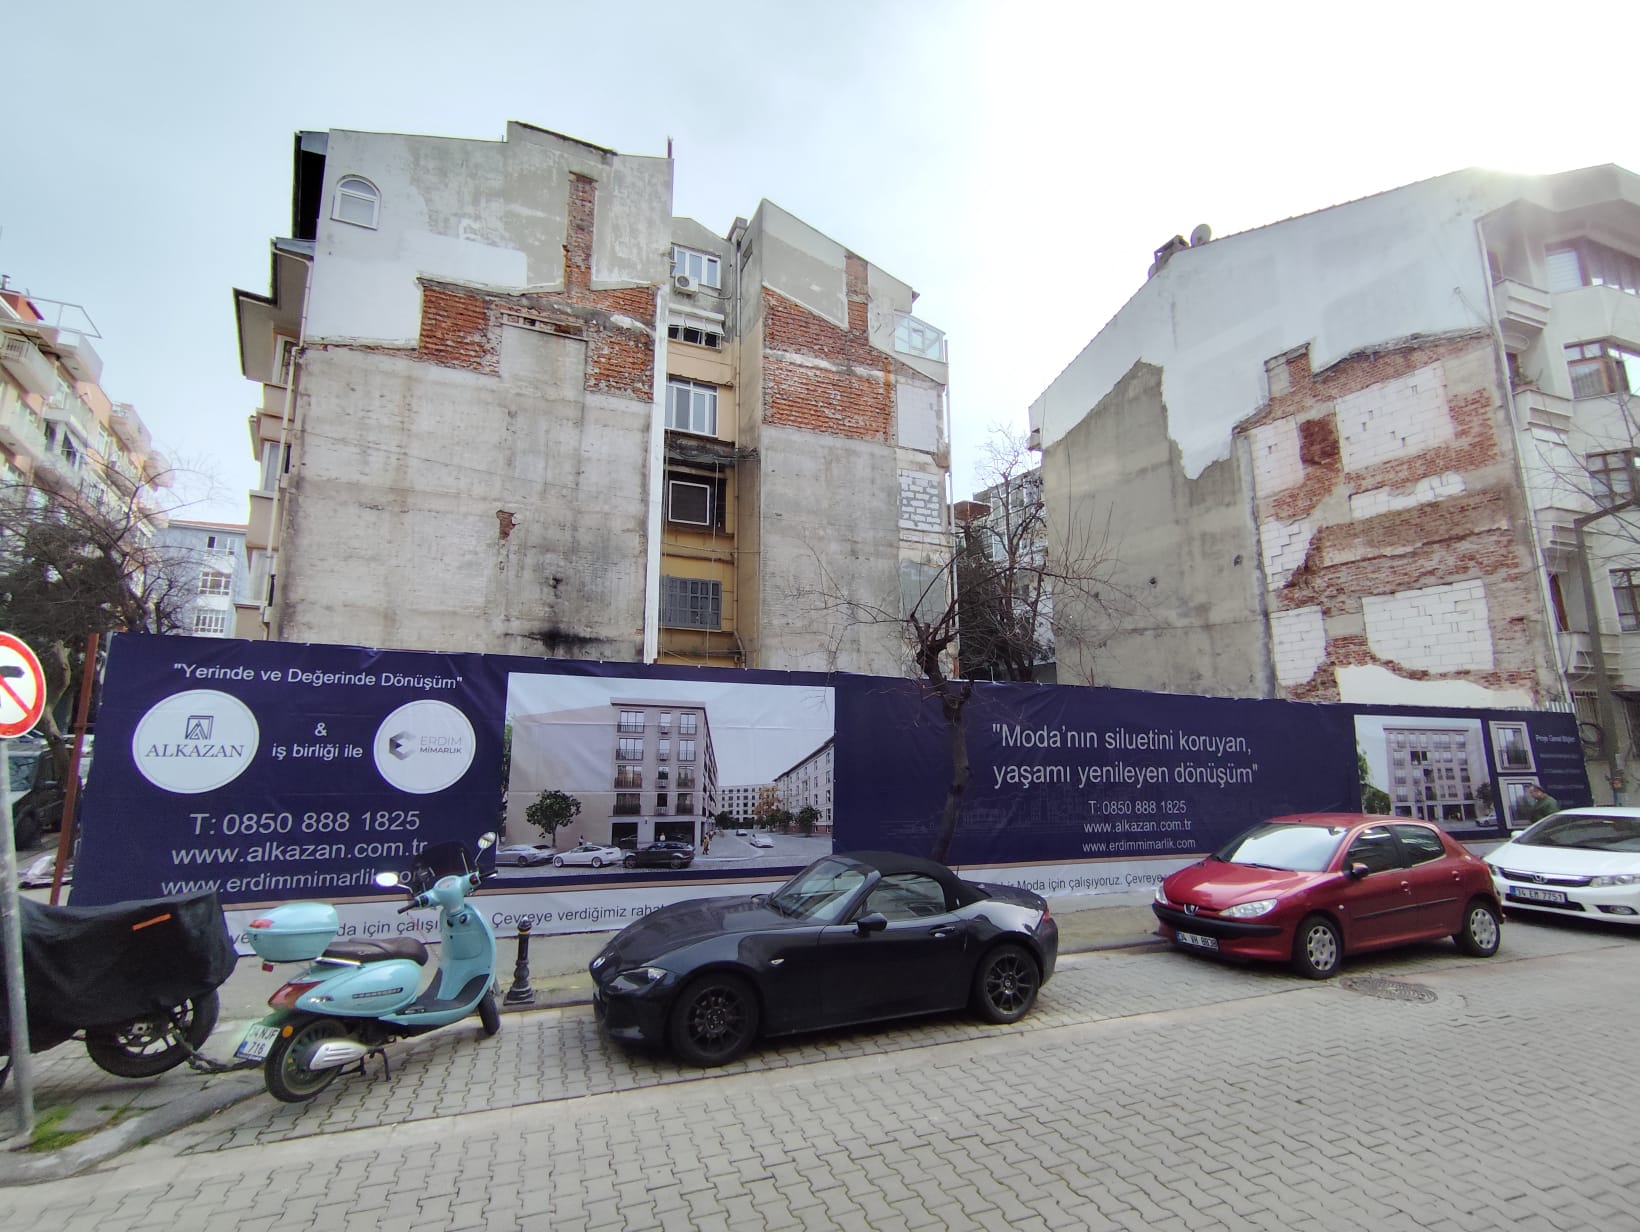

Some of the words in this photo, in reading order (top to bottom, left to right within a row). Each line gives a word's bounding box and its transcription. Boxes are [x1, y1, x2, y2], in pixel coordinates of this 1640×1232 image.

[173, 662, 255, 681] "Yerinde
[260, 671, 281, 682] ve
[287, 668, 376, 687] Değerinde
[381, 671, 463, 690] Dönüşüm"
[314, 722, 327, 736] &
[145, 743, 246, 758] ALKAZAN
[271, 743, 287, 761] iş
[292, 742, 339, 762] birliği
[344, 743, 363, 758] ile
[1104, 727, 1174, 750] siluetini
[1179, 730, 1252, 757] koruyan,
[993, 764, 1071, 789] yaşamı
[1077, 761, 1169, 788] yenileyen
[1174, 762, 1258, 788] dönüşüm"
[1102, 801, 1132, 815] 0850
[1135, 800, 1157, 815] 888
[1160, 800, 1187, 814] 1825
[222, 812, 293, 834] 0850
[301, 811, 350, 832] 888
[361, 810, 421, 831] 1825
[1083, 819, 1192, 834] www.alkazan.com.tr
[171, 838, 428, 866] www.alkazan.com.tr
[1082, 837, 1196, 853] www.erdimmimarlik.com
[1017, 879, 1046, 891] Moda
[1048, 877, 1066, 893] için
[1125, 873, 1163, 887] Çevreye
[362, 920, 391, 938] için
[557, 905, 627, 922] verdiğimiz
